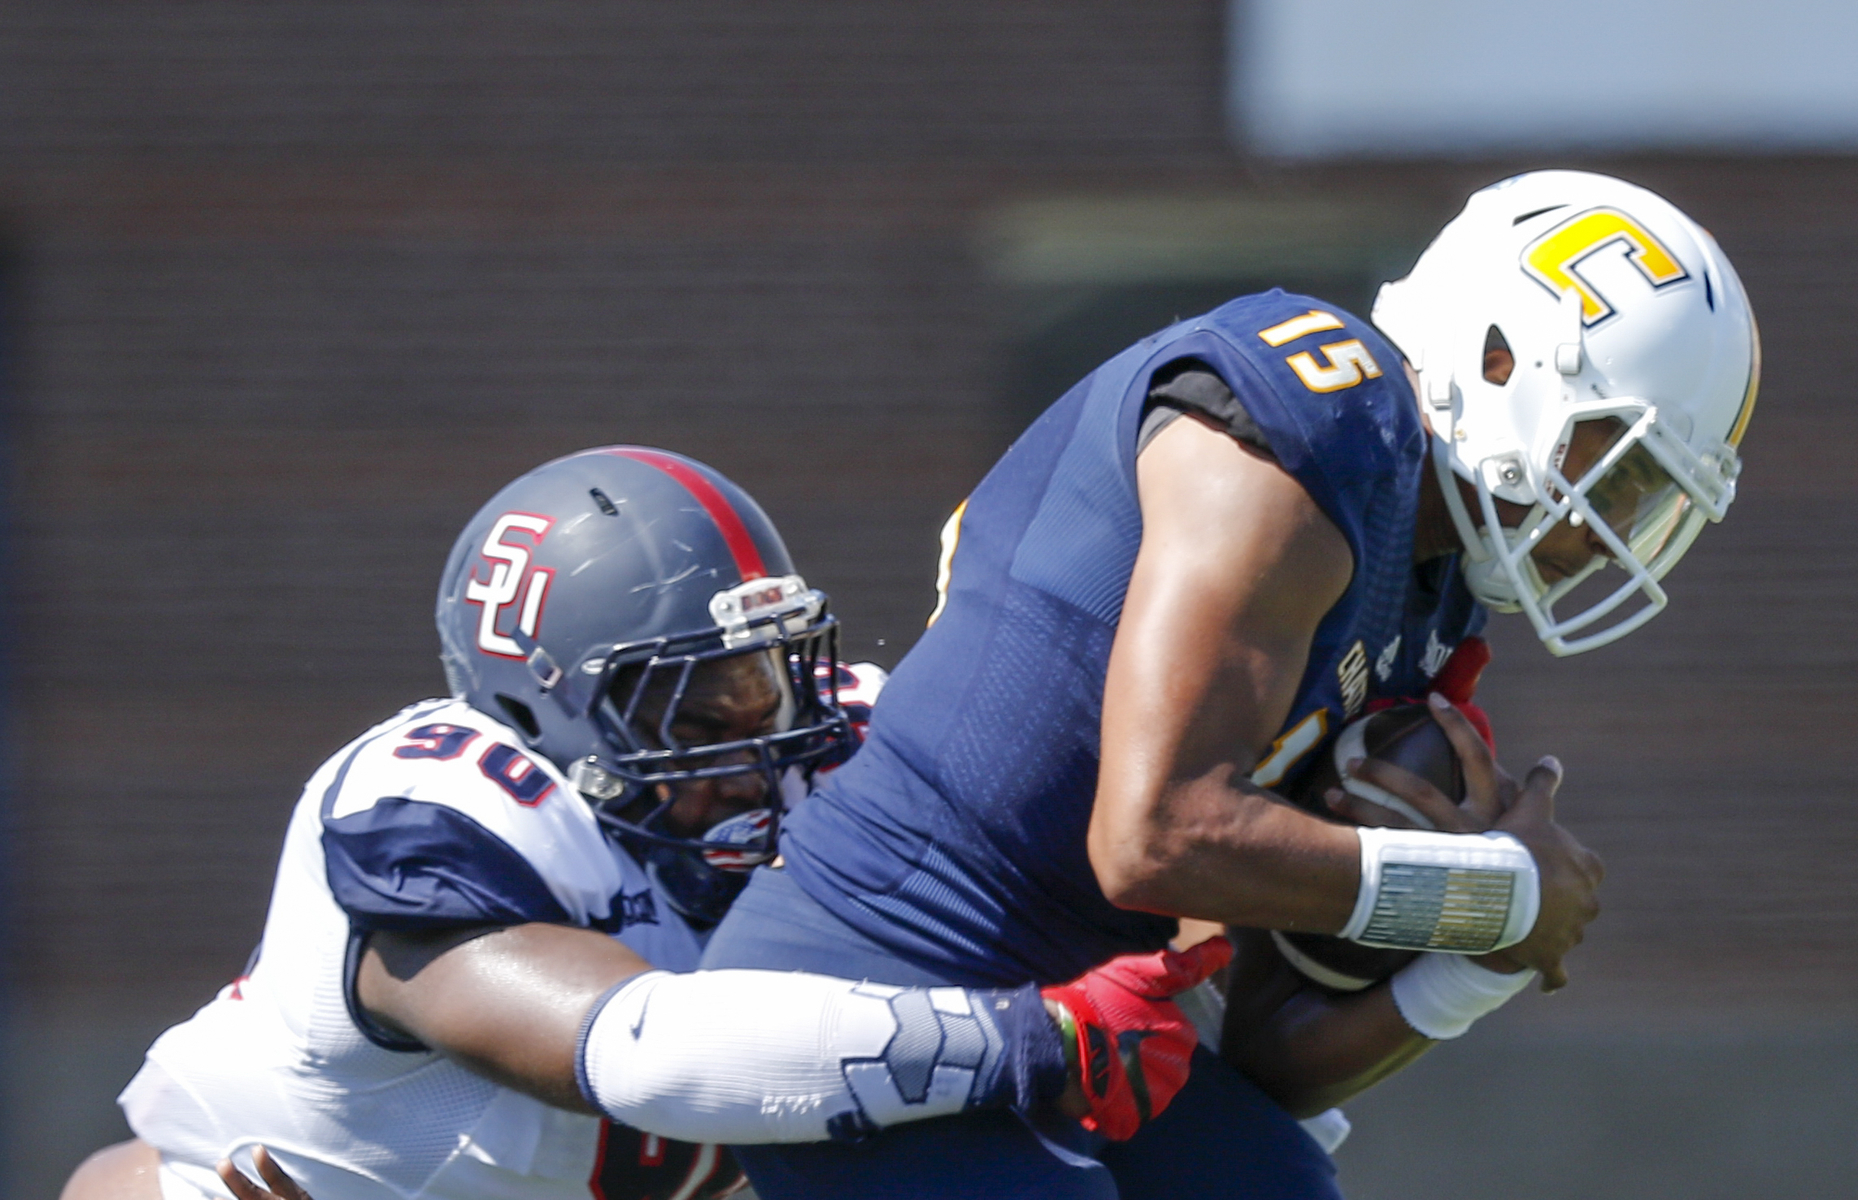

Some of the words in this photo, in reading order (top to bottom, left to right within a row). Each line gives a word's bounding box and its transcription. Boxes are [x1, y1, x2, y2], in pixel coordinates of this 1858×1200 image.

[1519, 206, 1692, 329] C
[1257, 309, 1384, 394] 15
[464, 510, 558, 663] SU
[392, 722, 558, 809] 90
